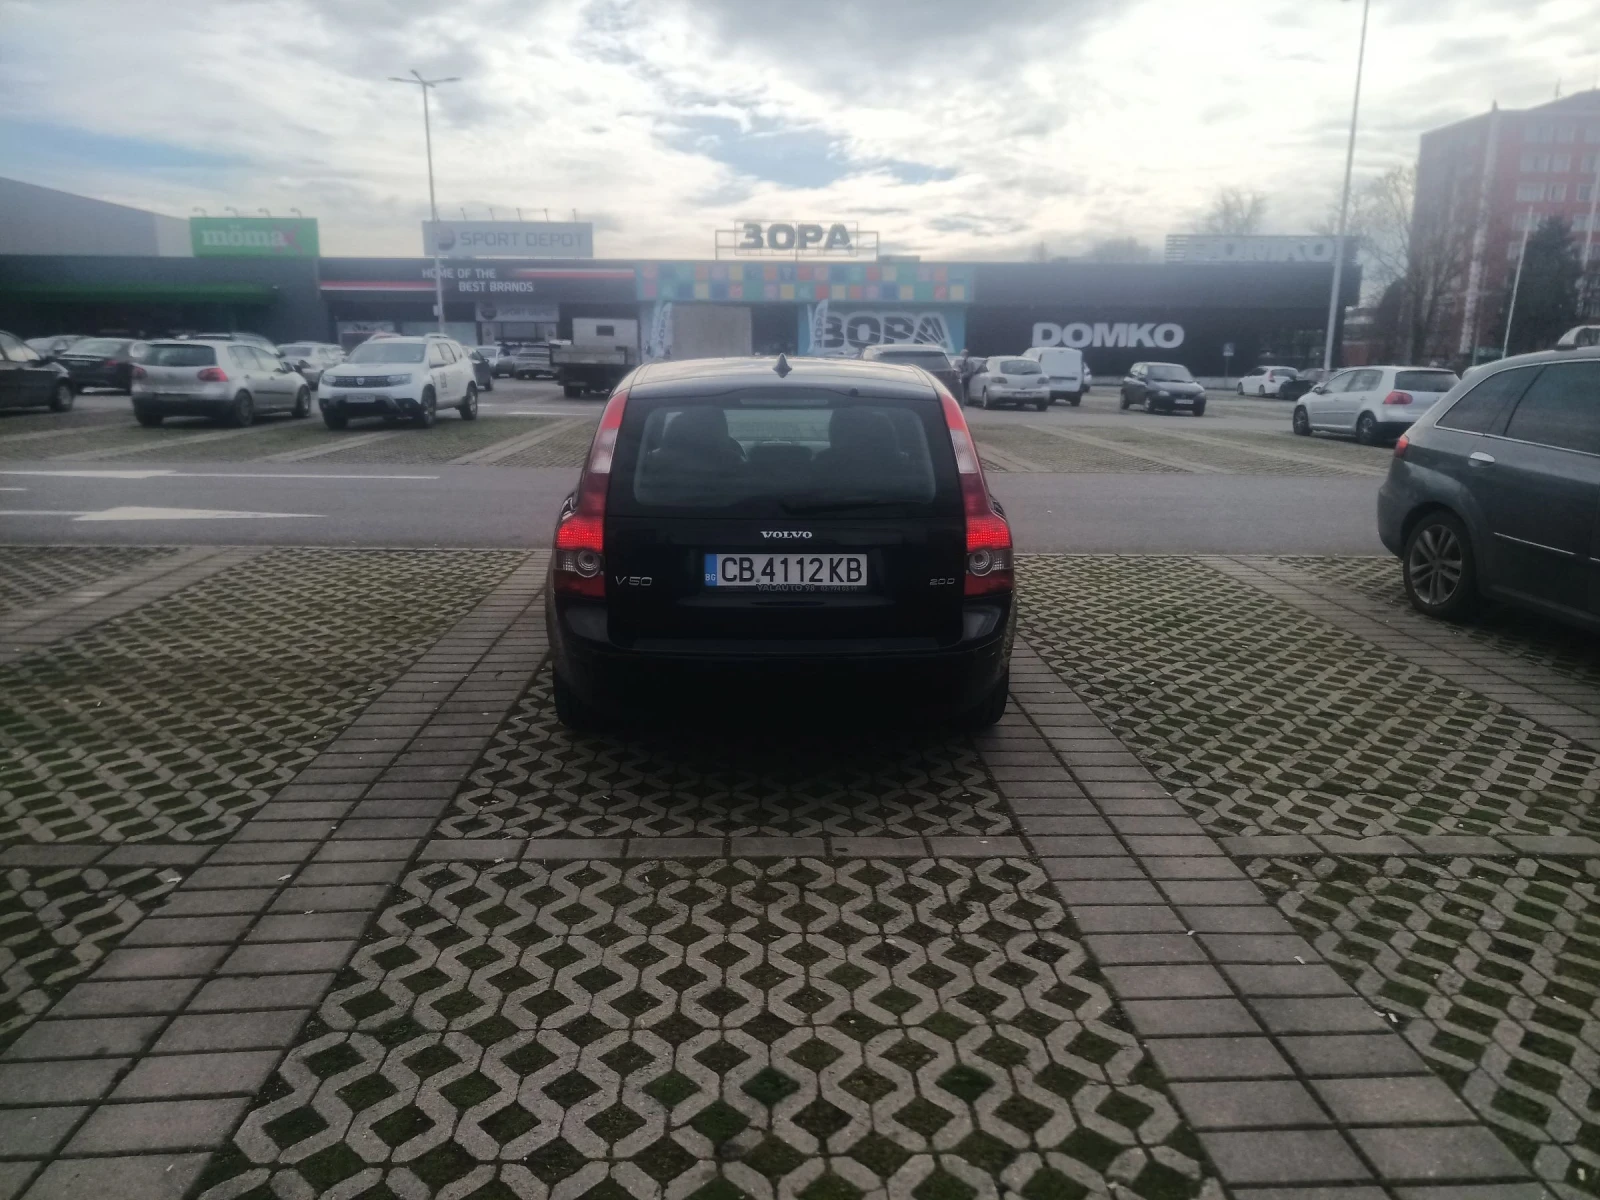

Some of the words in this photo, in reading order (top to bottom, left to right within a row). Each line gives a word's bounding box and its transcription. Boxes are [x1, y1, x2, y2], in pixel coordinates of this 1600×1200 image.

[460, 231, 520, 247] SPORT
[526, 231, 584, 247] DEPOT
[739, 223, 854, 250] ЗОРА
[422, 268, 453, 279] HOME
[457, 268, 472, 279] OF
[475, 268, 497, 279] THE
[459, 281, 486, 293] BEST
[490, 281, 534, 293] BRANDS
[1032, 322, 1185, 349] DOMKO
[760, 530, 813, 539] VOLVO
[705, 573, 716, 581] BG
[756, 584, 803, 592] VALAUTO
[805, 584, 815, 592] 98
